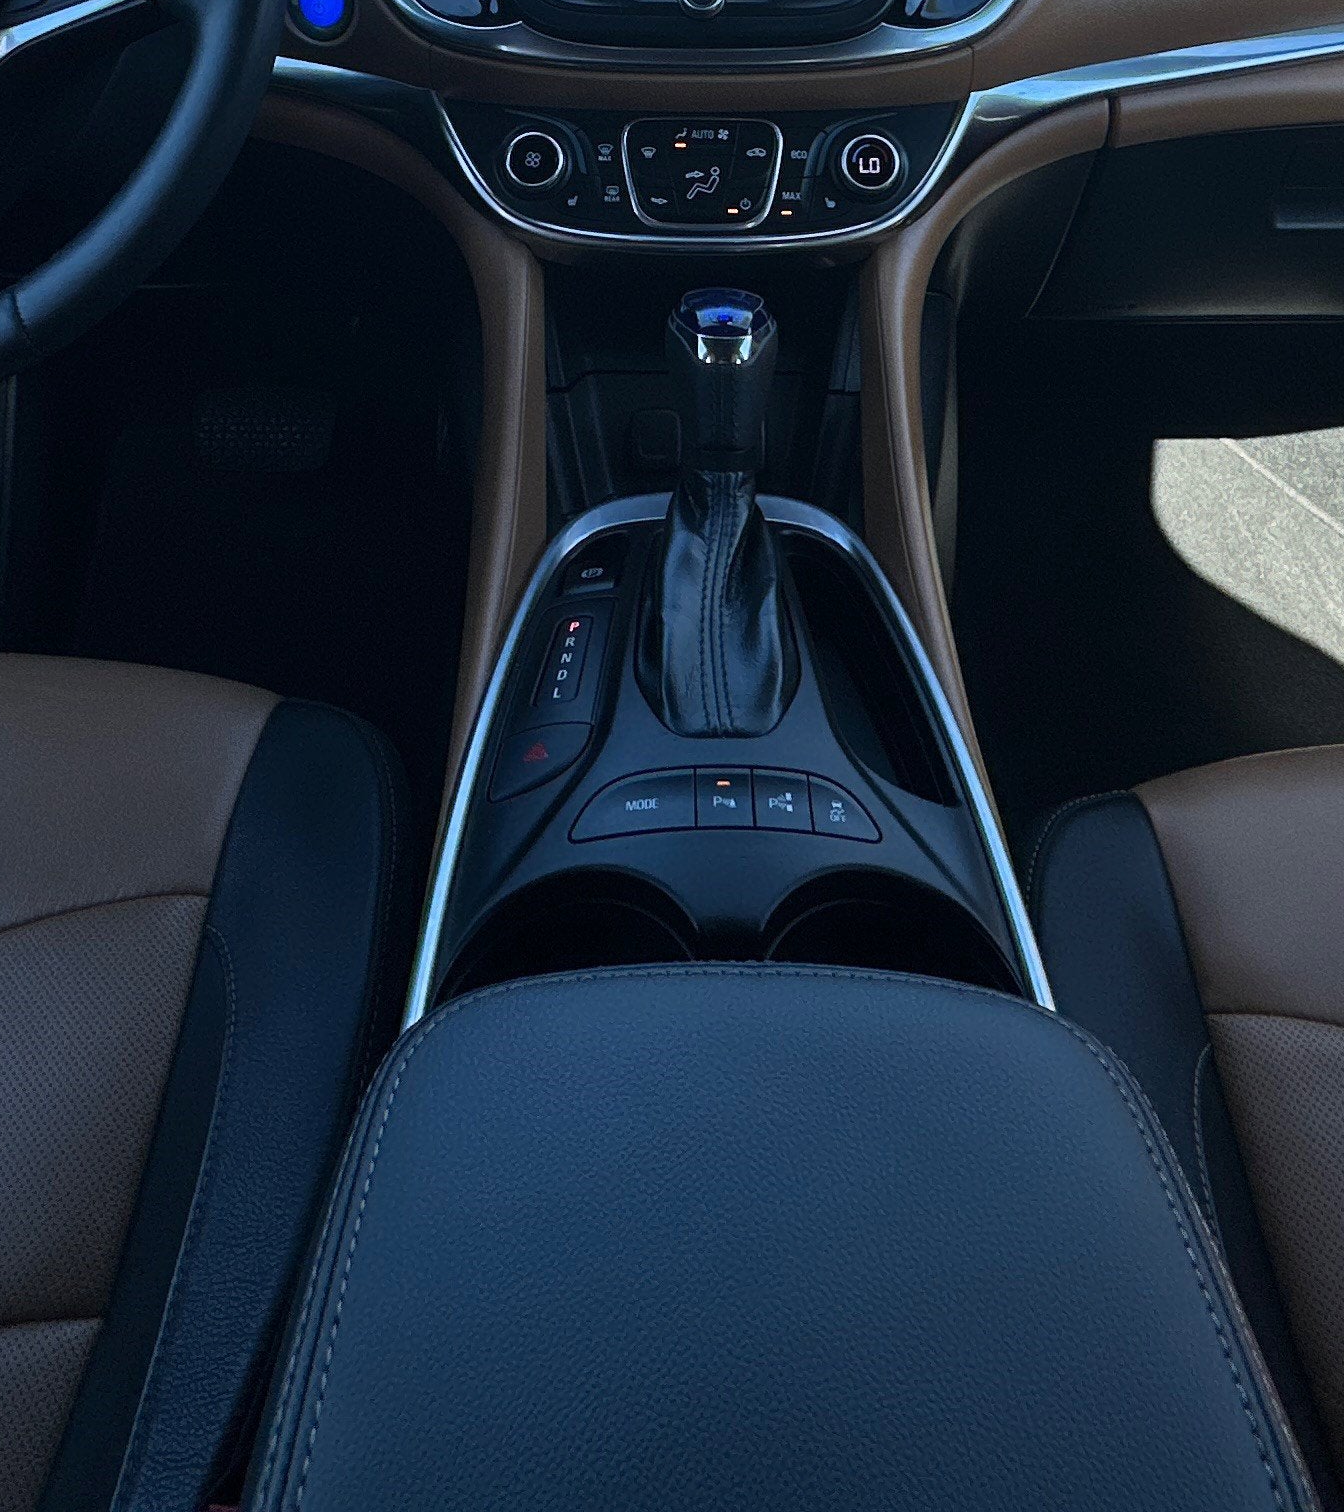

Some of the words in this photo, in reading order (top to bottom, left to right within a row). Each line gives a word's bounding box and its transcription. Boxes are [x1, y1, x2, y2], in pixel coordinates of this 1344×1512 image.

[691, 129, 714, 139] AUTO
[858, 157, 881, 174] LO
[781, 191, 802, 201] MAX
[569, 619, 581, 632] P
[564, 636, 576, 648] R
[560, 652, 573, 664] N
[557, 669, 568, 681] D
[552, 687, 562, 699] L
[625, 797, 660, 811] MODE
